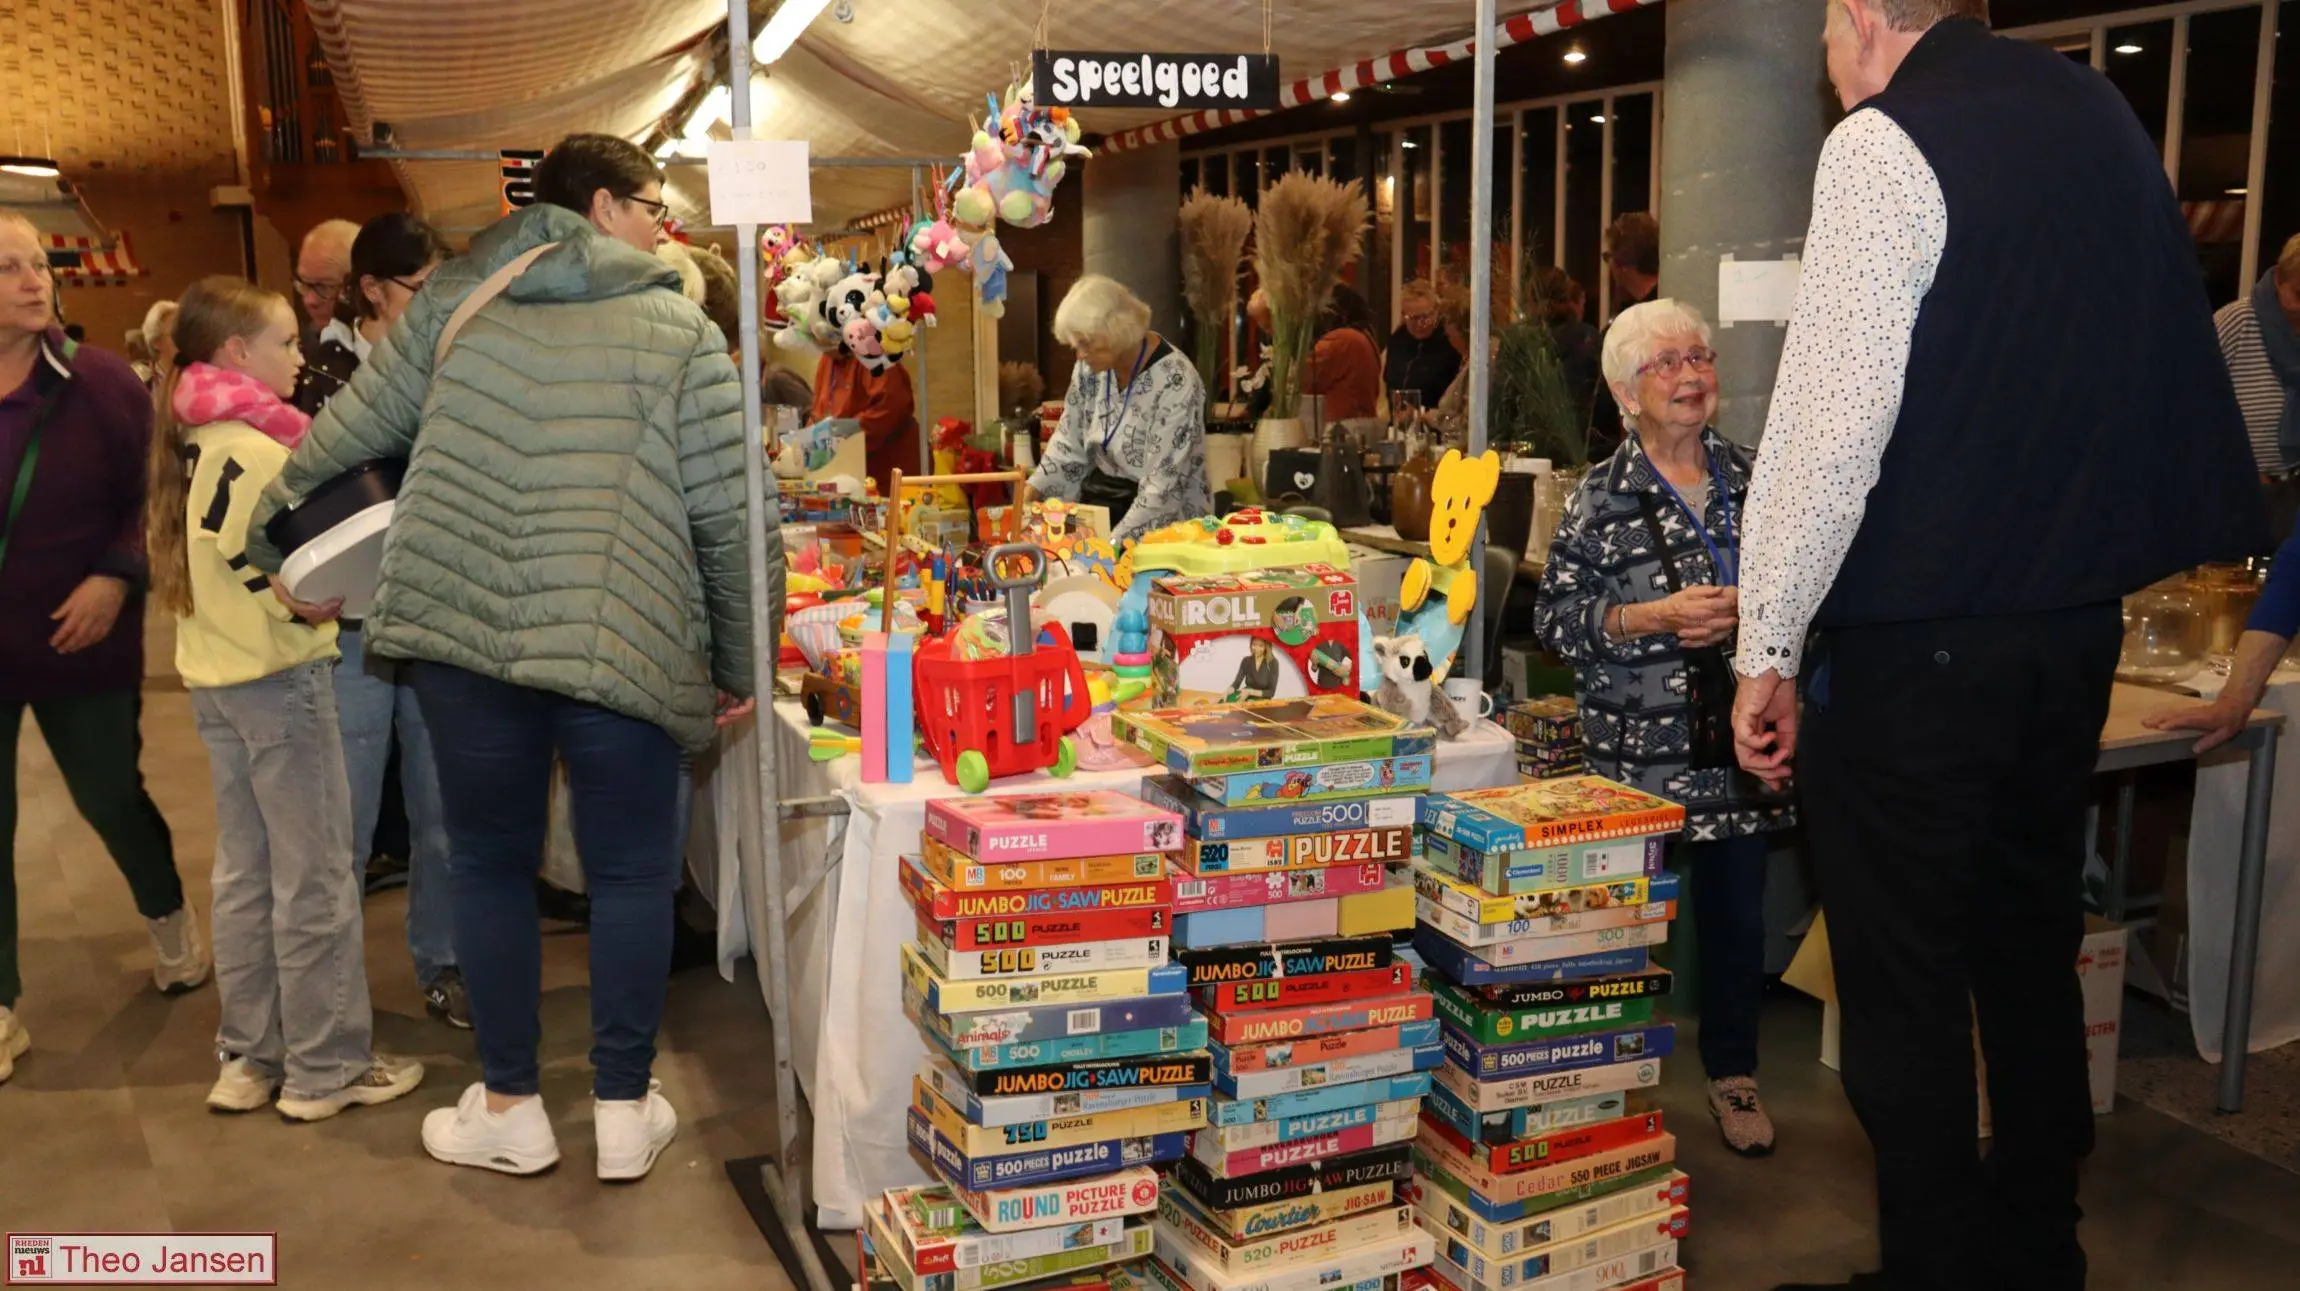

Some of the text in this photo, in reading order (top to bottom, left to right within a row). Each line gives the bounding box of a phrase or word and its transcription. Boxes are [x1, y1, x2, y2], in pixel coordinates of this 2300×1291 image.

[1052, 54, 1248, 108] Speelgoed
[1187, 595, 1260, 626] ROLL
[1321, 803, 1363, 824] 500
[989, 834, 1047, 851] PUZZLE
[1541, 820, 1604, 838] SIMPLEX
[1201, 843, 1228, 863] 520
[1294, 830, 1403, 866] PUZZLE
[998, 868, 1027, 881] 100
[956, 895, 1026, 916] JUMBO
[1100, 886, 1156, 908] PUZZLE
[1267, 890, 1282, 899] 500
[976, 920, 1081, 944] 500 PUZZLE
[1507, 919, 1530, 933] 100
[981, 949, 1091, 974] 500 PUZZLE
[1193, 961, 1256, 982] JUMBO
[1325, 952, 1376, 972] PUZZLE
[975, 983, 1007, 998] 500
[1041, 976, 1098, 992] PUZZLE
[1235, 981, 1280, 1004] 500
[1512, 990, 1564, 1003] JUMBO
[1589, 980, 1644, 998] PUZZLE
[1241, 1018, 1303, 1040] JUMBO
[1368, 1004, 1417, 1026] PUZZLE
[1521, 1003, 1622, 1030] PUZZLE
[1009, 1044, 1041, 1060] 500
[1320, 1040, 1347, 1052] Puzzle
[1501, 1039, 1604, 1067] 500 PIECES puzzle
[994, 1072, 1065, 1094] JUMBO
[1139, 1065, 1196, 1084] PUZZLE
[1533, 1073, 1582, 1093] PUZZLE
[1003, 1118, 1093, 1145] 750 PUZZLE
[1288, 1109, 1367, 1137] PUZZLE
[1526, 1104, 1596, 1137] PUZZLE
[996, 1142, 1109, 1177] 500 PIECES puzzle
[1260, 1138, 1340, 1169] PUZZLE
[1509, 1141, 1549, 1166] 500
[1225, 1181, 1281, 1203] JUMBO
[1346, 1160, 1402, 1183] PUZZLE
[1516, 1175, 1565, 1197] Cedar
[1570, 1170, 1590, 1185] 550
[1593, 1161, 1622, 1181] PIECE
[1626, 1151, 1661, 1172] JIGSAW
[1066, 1183, 1127, 1203] PICTURE
[997, 1192, 1060, 1223] ROUND
[1069, 1197, 1125, 1218] PUZZLE
[1245, 1204, 1321, 1236] Courtier
[1184, 1218, 1221, 1254] PUZZLE
[1244, 1229, 1337, 1264] 520 PUZZLE
